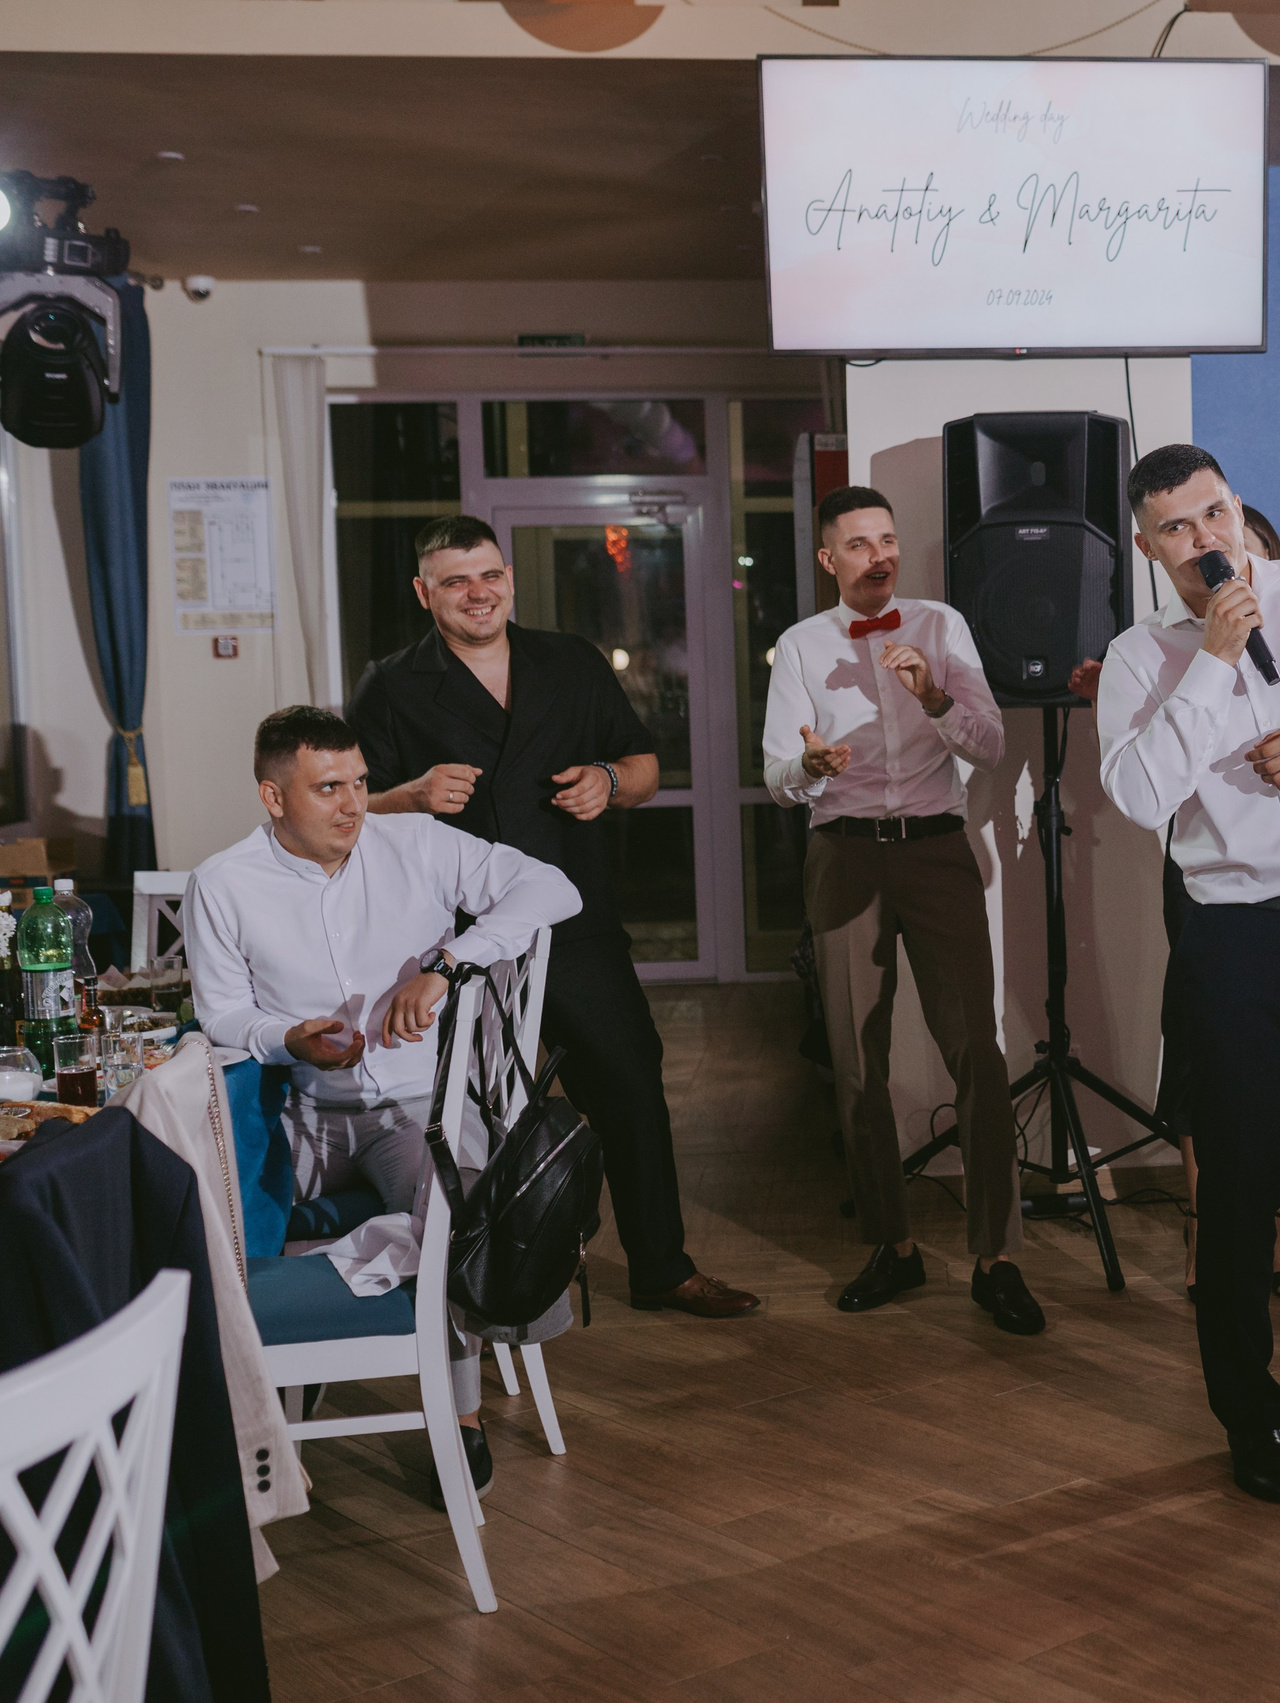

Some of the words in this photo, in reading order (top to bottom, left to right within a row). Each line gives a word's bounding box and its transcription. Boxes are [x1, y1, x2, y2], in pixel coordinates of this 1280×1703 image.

[957, 97, 1034, 142] Wedding
[1040, 100, 1069, 144] day
[979, 194, 1000, 226] &
[1017, 171, 1231, 262] Margarita
